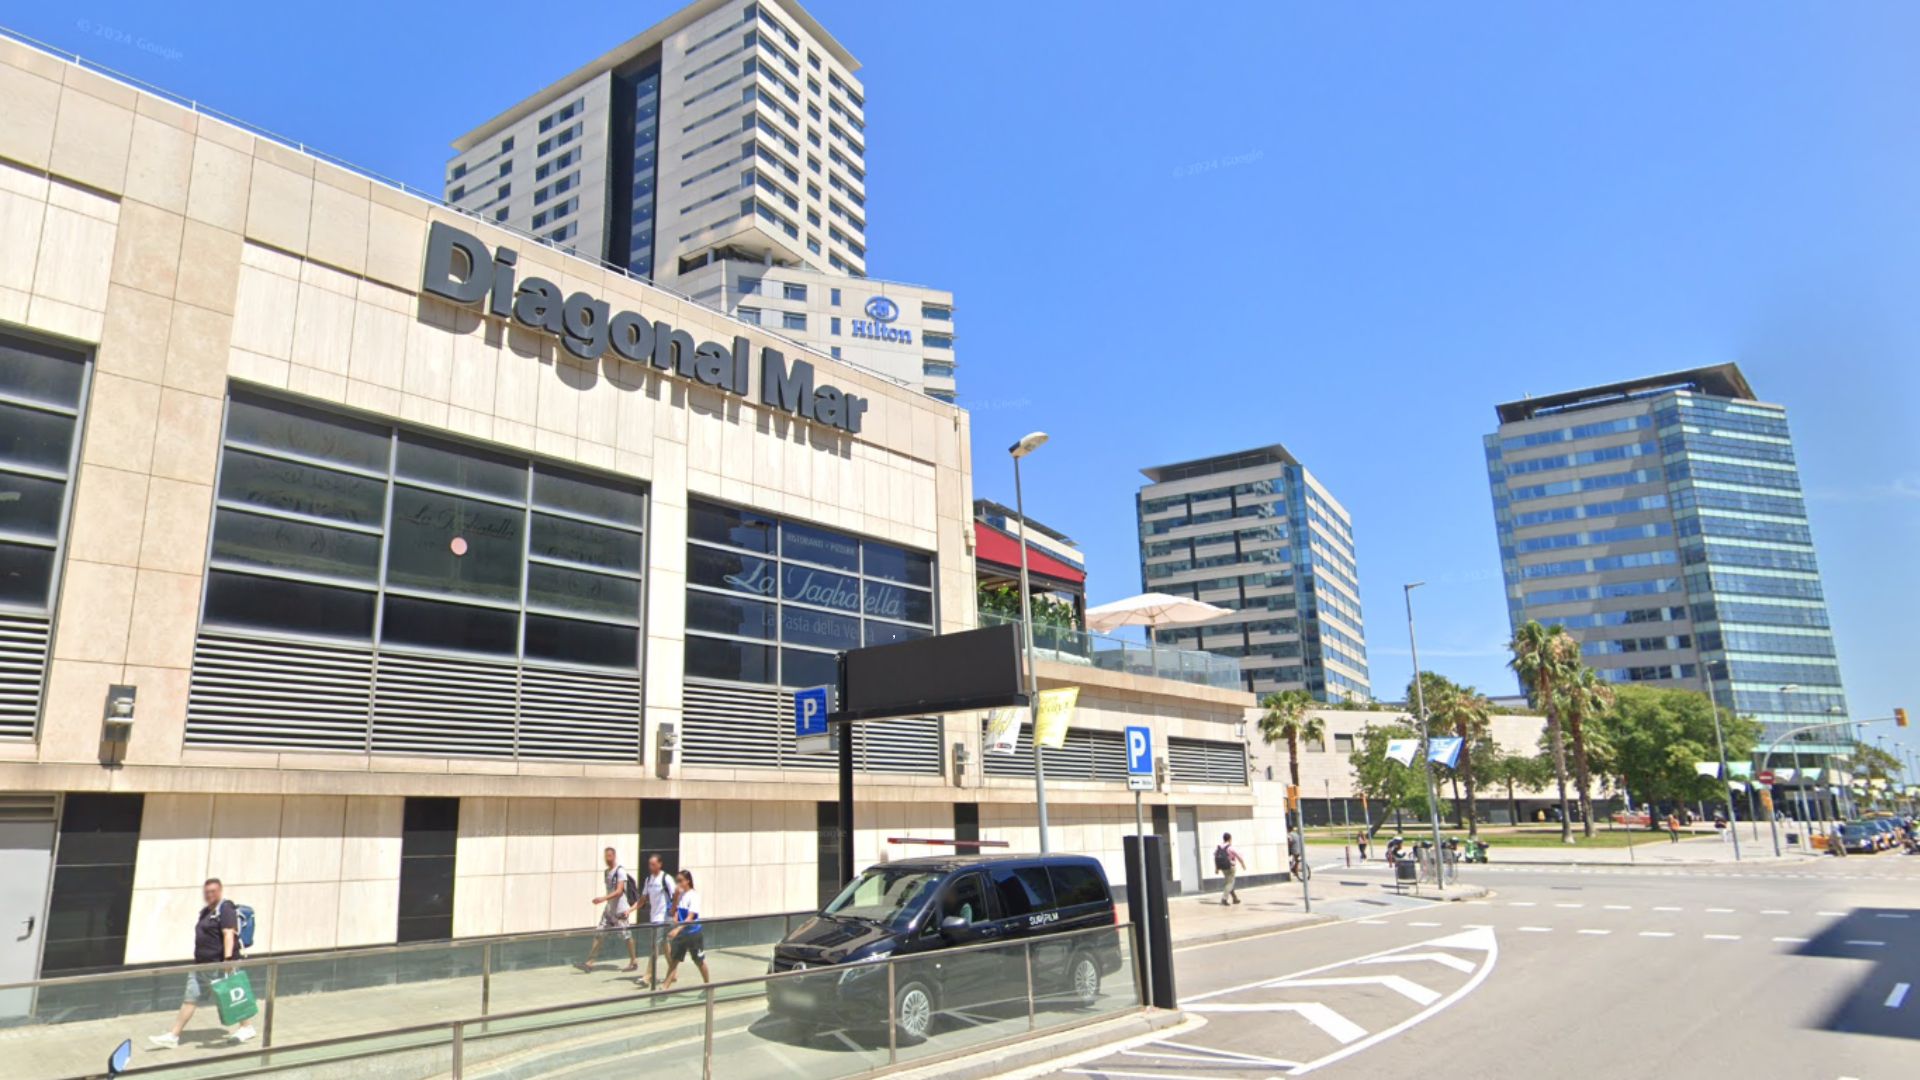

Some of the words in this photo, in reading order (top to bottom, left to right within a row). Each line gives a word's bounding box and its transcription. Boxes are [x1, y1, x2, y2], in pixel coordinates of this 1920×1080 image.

[423, 220, 750, 396] Diagonal
[760, 347, 868, 433] Mar
[852, 318, 912, 345] Hilton
[723, 549, 776, 594] La
[803, 698, 818, 729] P
[1129, 730, 1146, 769] P
[230, 986, 245, 1002] D
